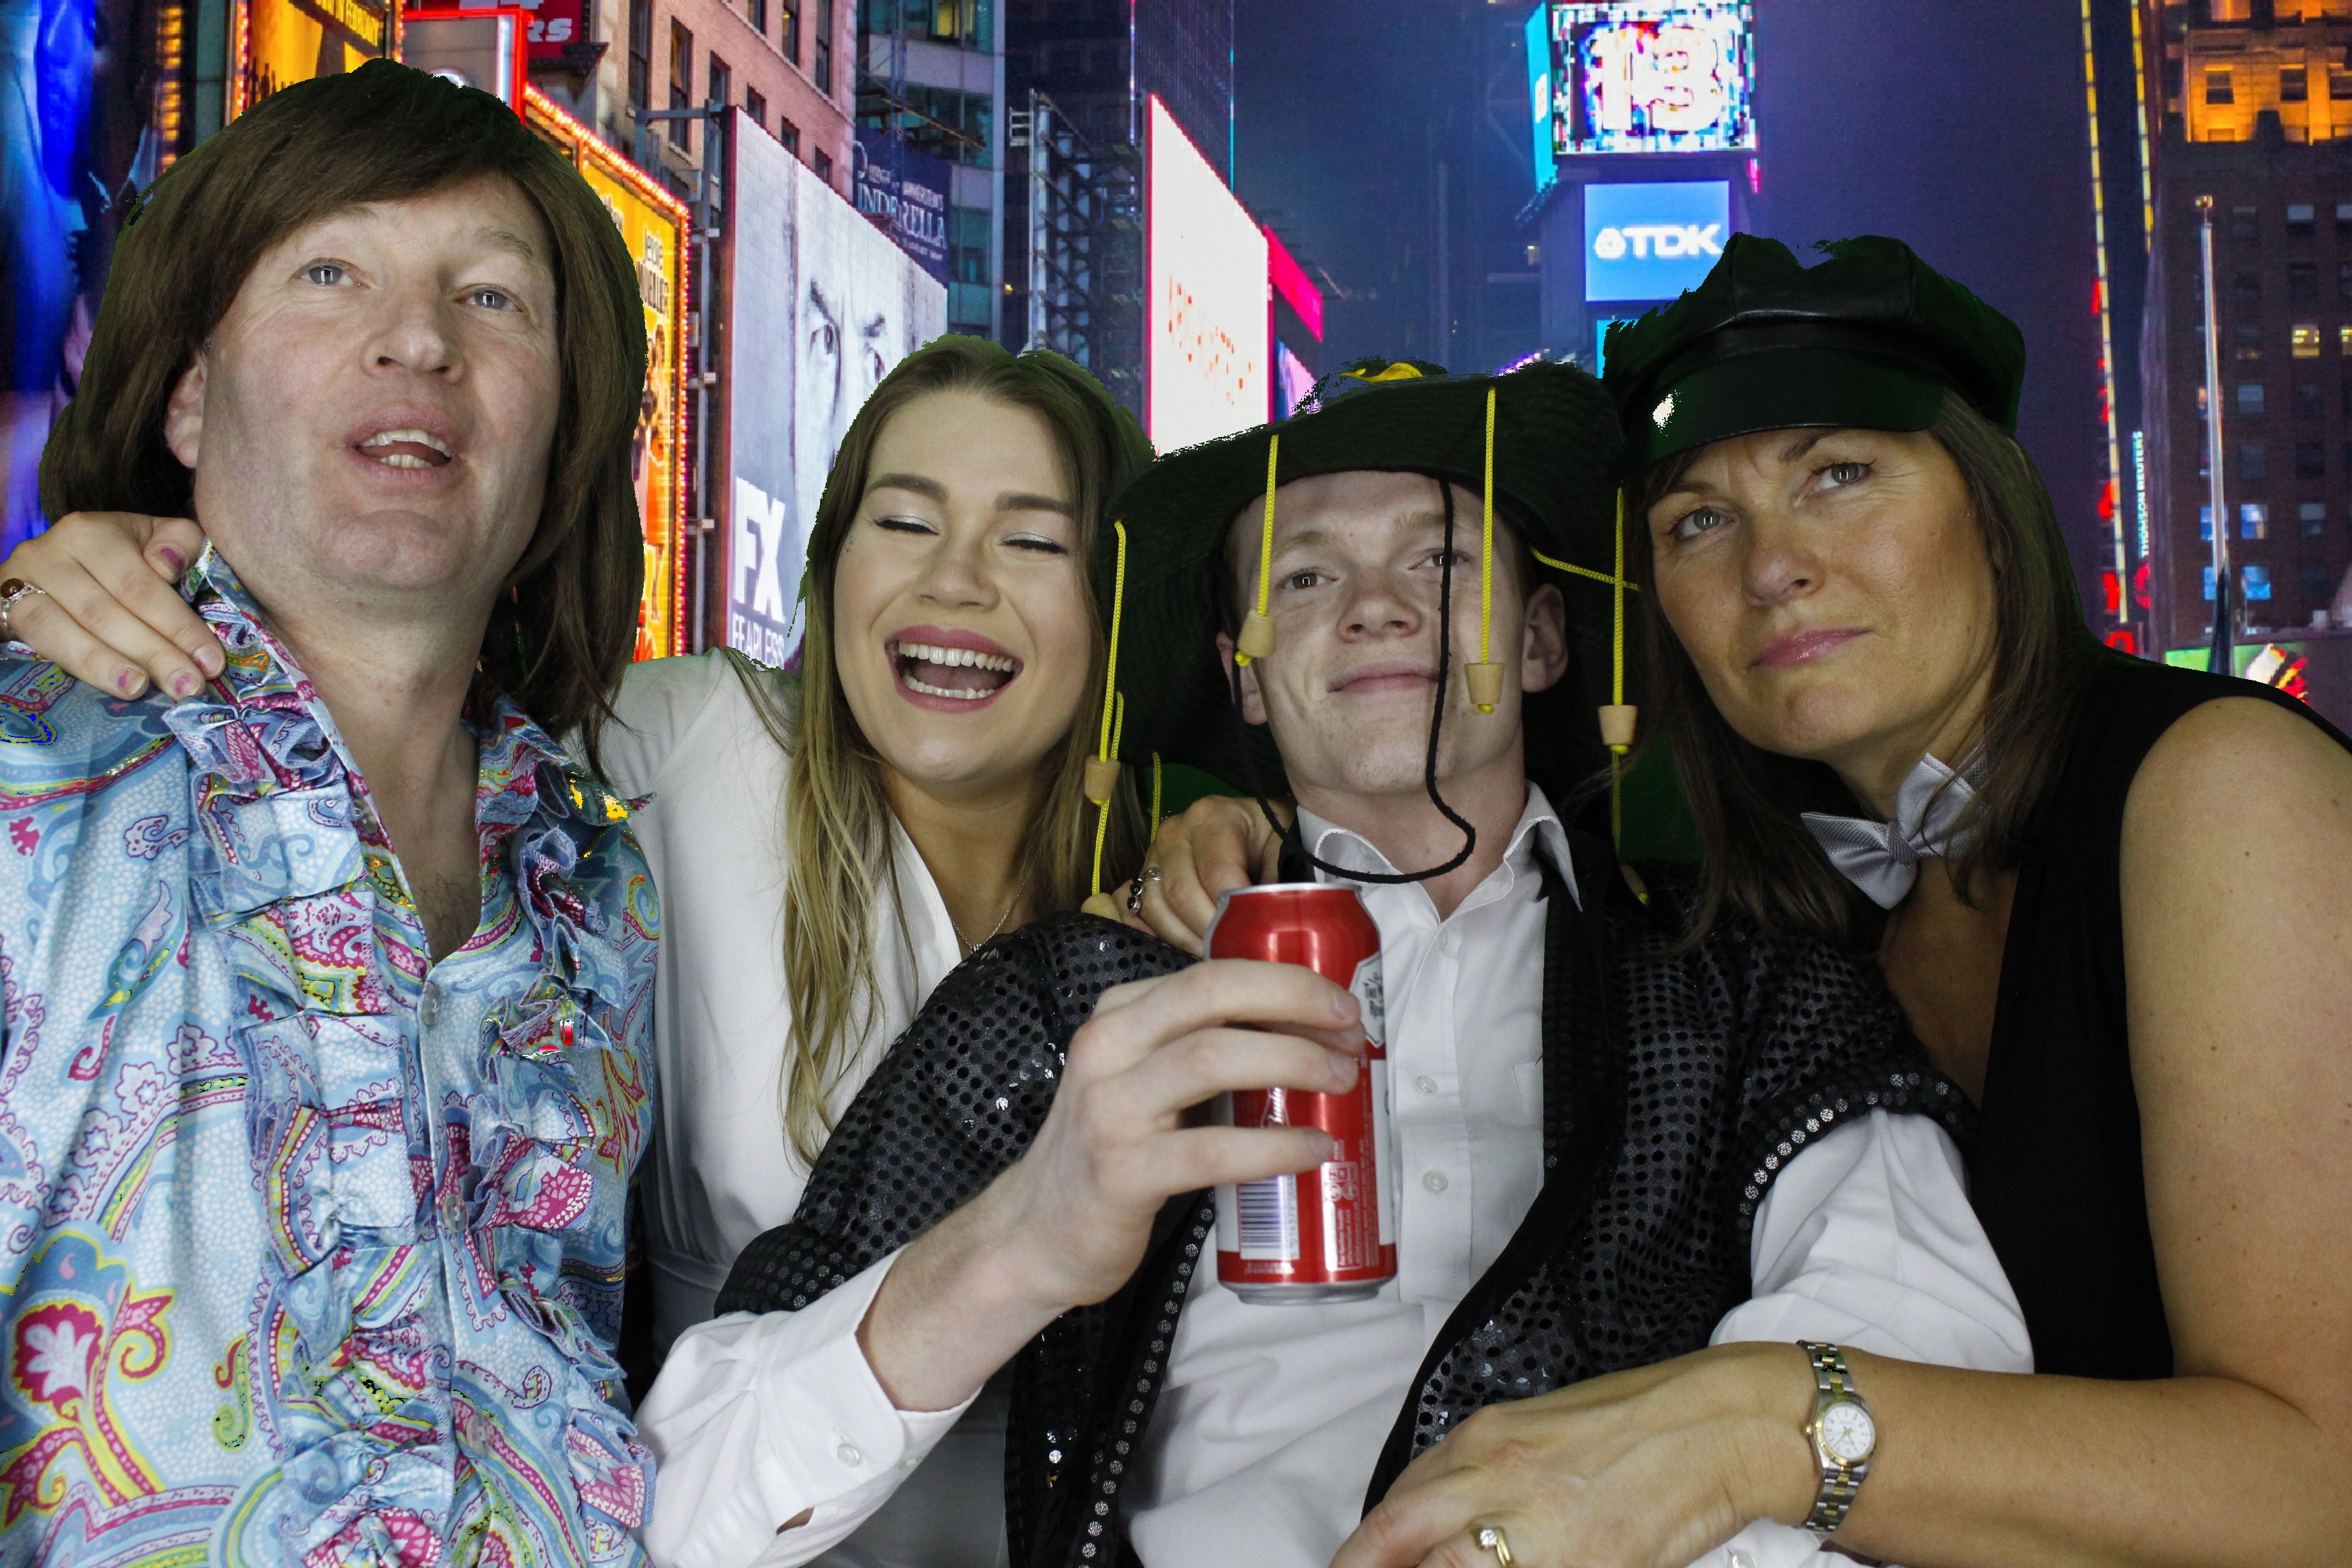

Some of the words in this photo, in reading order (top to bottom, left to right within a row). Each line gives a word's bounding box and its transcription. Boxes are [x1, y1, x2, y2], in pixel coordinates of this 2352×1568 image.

[1622, 224, 1722, 257] TDK
[734, 474, 785, 624] FX
[732, 611, 784, 670] FEARLESS
